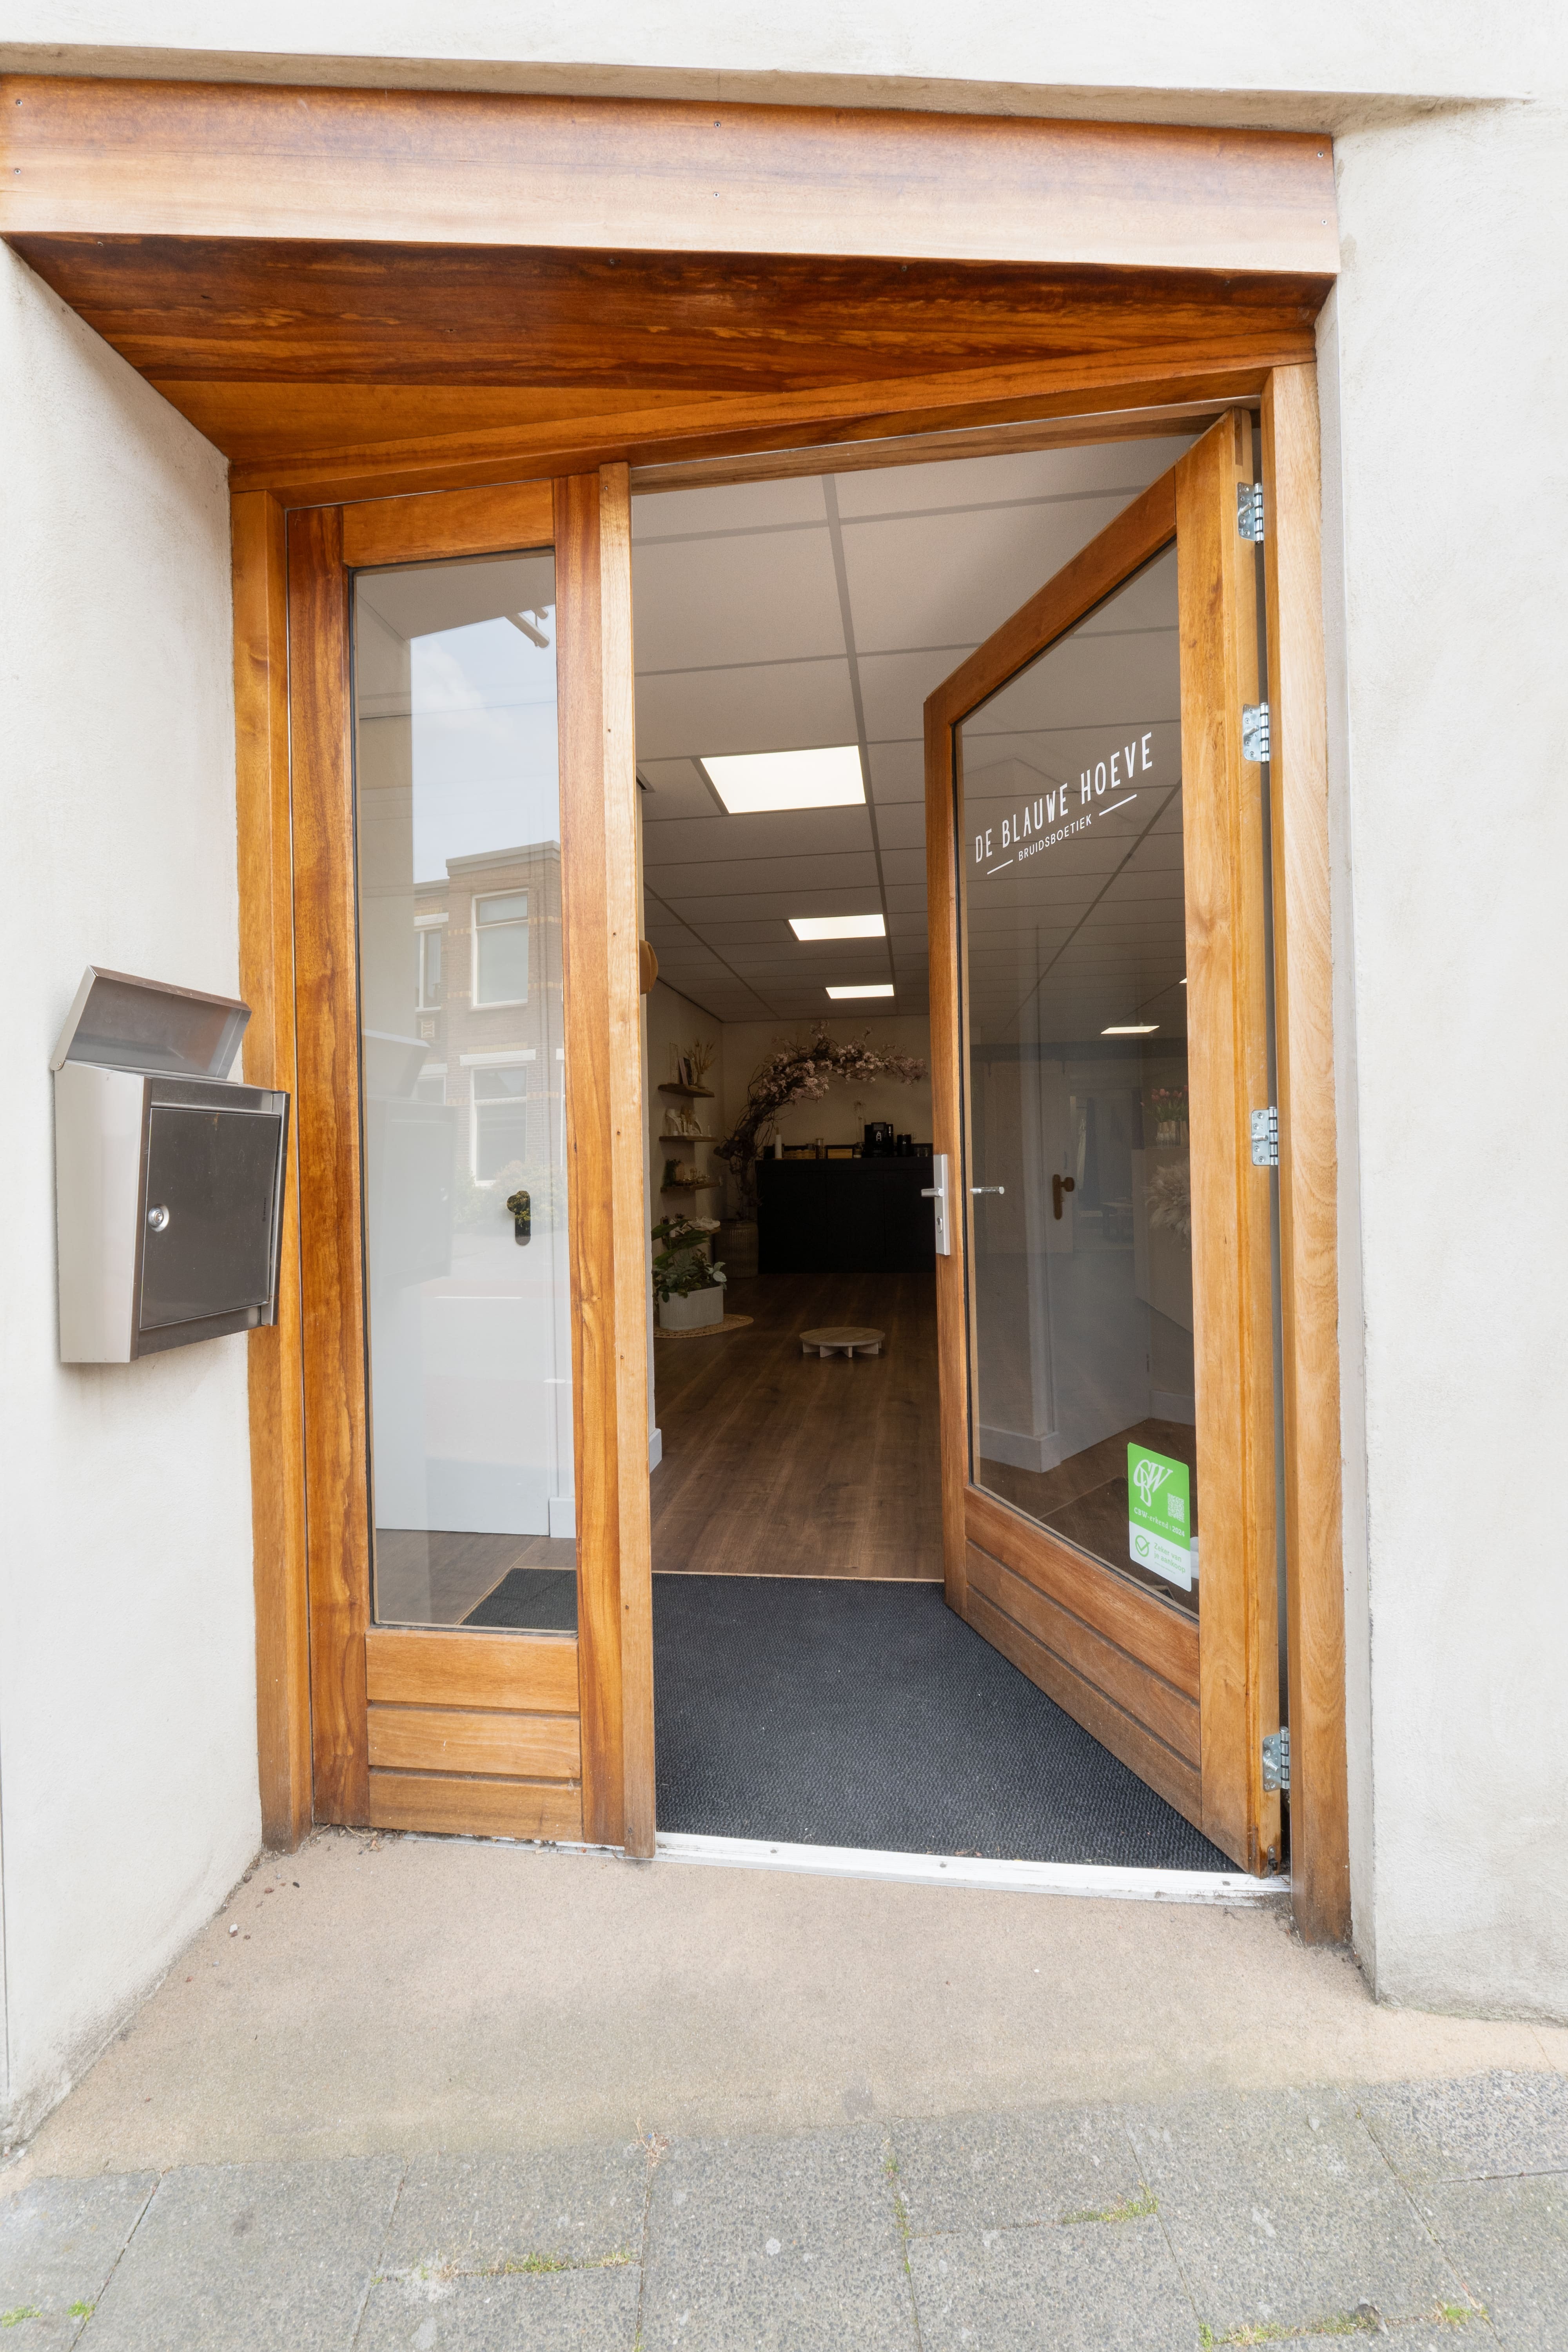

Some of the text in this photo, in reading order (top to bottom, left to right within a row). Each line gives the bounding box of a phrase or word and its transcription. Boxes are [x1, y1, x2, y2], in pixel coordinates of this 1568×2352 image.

[976, 732, 1152, 863] DE BLAUWE HOEVE
[1019, 814, 1092, 861] BRUIDSBOETIEK
[1134, 1507, 1185, 1537] CBW-erkend 2024
[1154, 1543, 1181, 1562] Zeker van
[1161, 1556, 1185, 1573] aankoop
